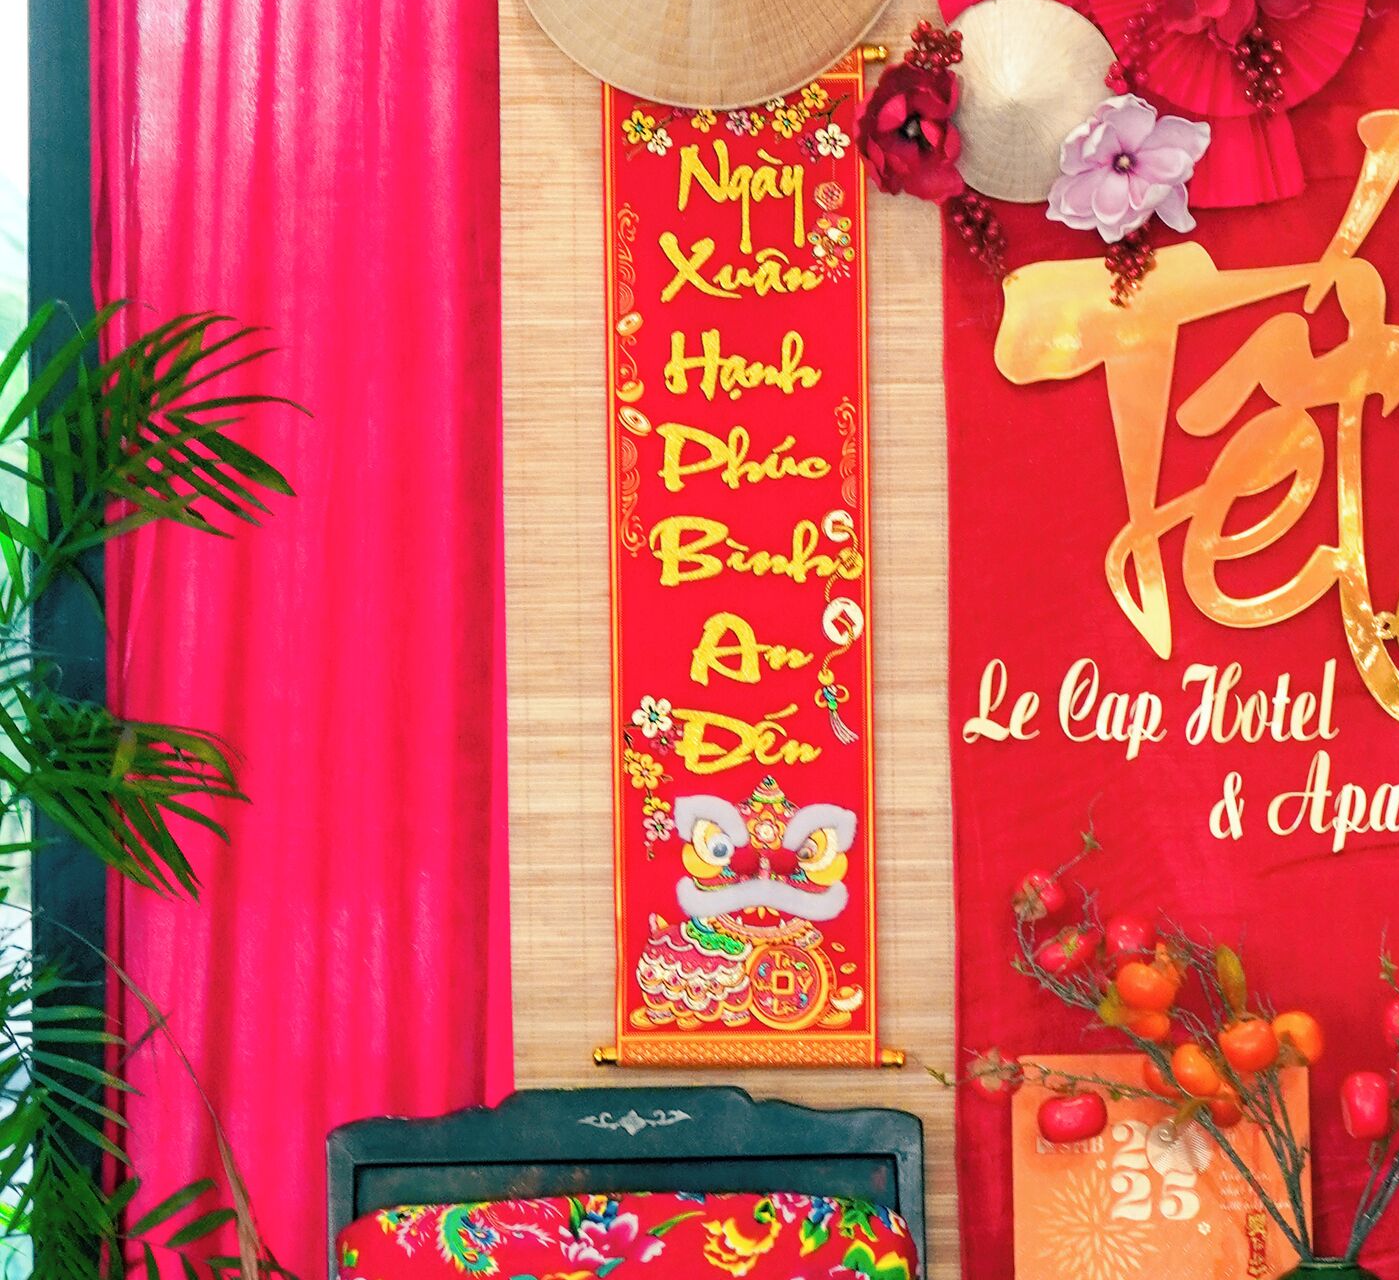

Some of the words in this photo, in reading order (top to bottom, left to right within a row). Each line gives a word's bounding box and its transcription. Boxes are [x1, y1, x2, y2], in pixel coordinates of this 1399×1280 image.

[678, 138, 806, 255] Ngày
[658, 230, 825, 304] Xuân
[663, 328, 822, 402] Hạnh
[655, 422, 831, 492] Phúc
[648, 515, 842, 588] Bình
[689, 611, 814, 686] An
[671, 703, 822, 775] Đến
[962, 658, 1041, 744] Le
[1058, 657, 1168, 761] Cap
[1181, 657, 1340, 746] Hotel
[1208, 771, 1245, 841] &
